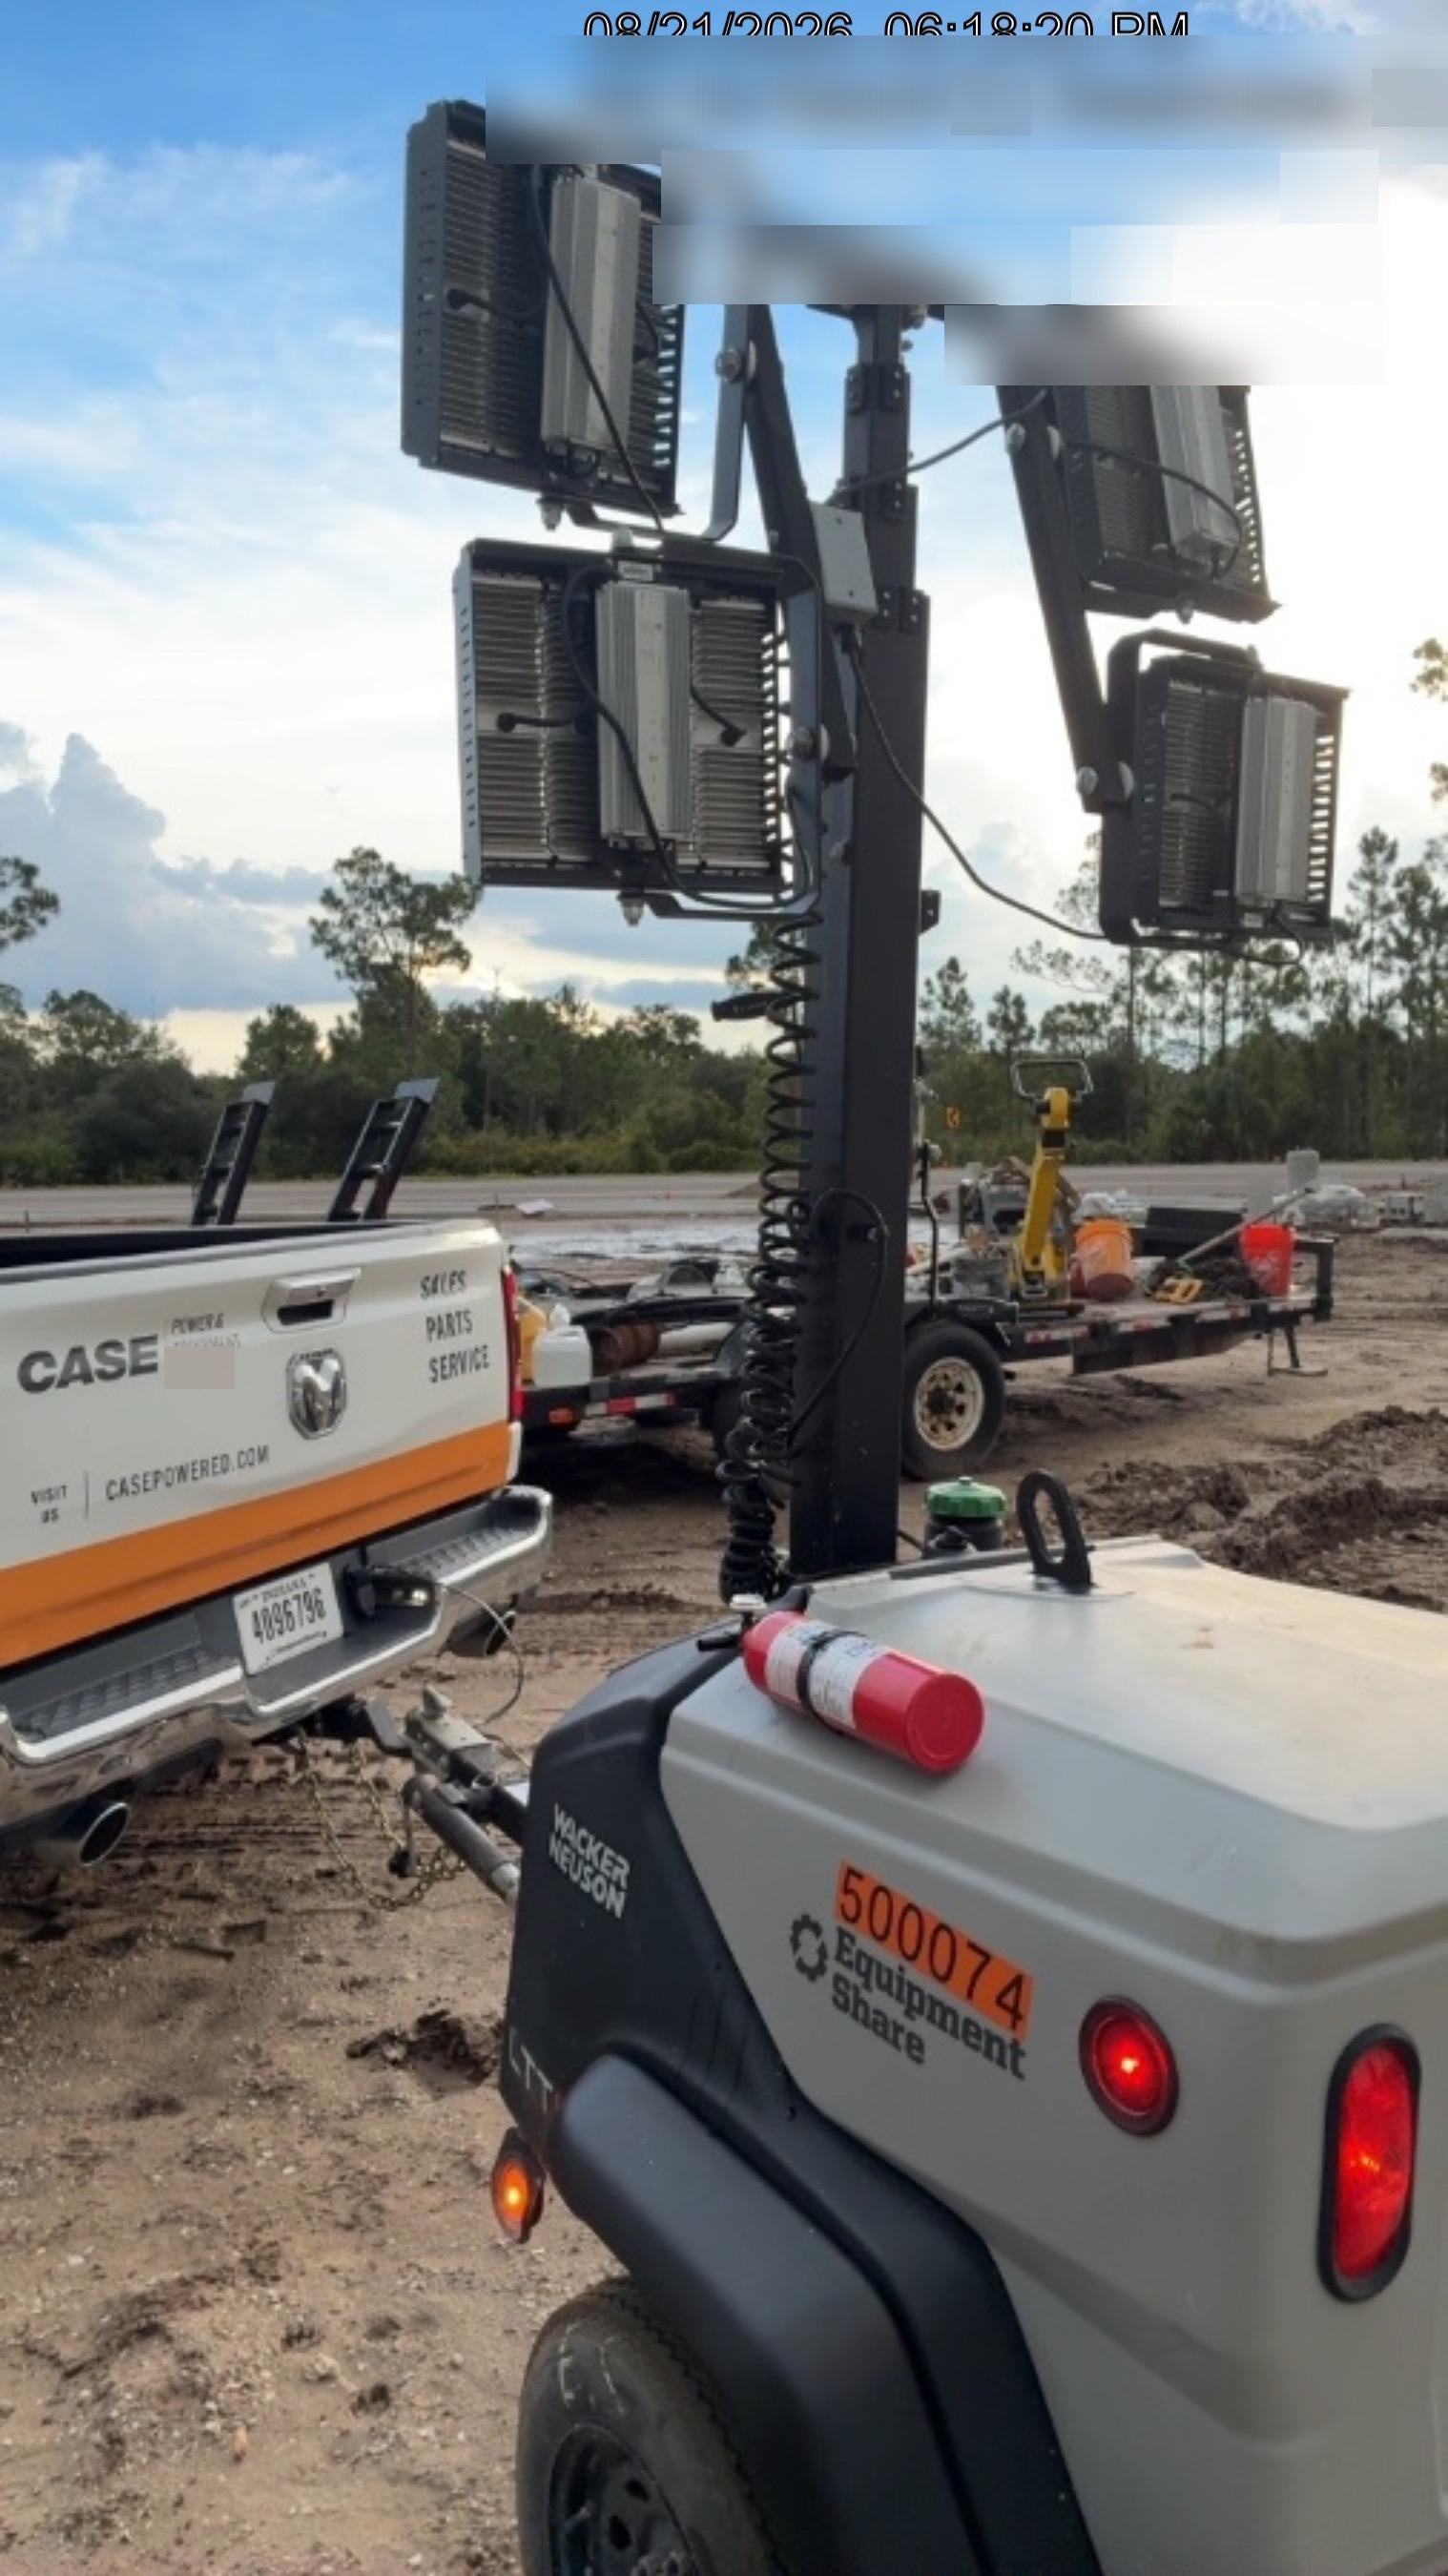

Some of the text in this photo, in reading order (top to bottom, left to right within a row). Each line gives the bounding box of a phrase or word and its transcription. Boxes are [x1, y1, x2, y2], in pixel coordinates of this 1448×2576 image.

[421, 1270, 466, 1298] SALES
[426, 1308, 473, 1342] PARTS
[17, 1334, 158, 1394] CASE
[429, 1345, 489, 1383] SERVICE
[31, 1485, 67, 1506] VISIT
[106, 1444, 270, 1501] CASEPOWERED.COM
[41, 1507, 59, 1524] US
[251, 1587, 327, 1644] 4096796
[554, 1802, 630, 1890] WACKER
[549, 1831, 626, 1919] NEUSON
[839, 1865, 1025, 2031] 500074
[832, 1971, 925, 2066] Share
[835, 1925, 1026, 2081] Equipment
